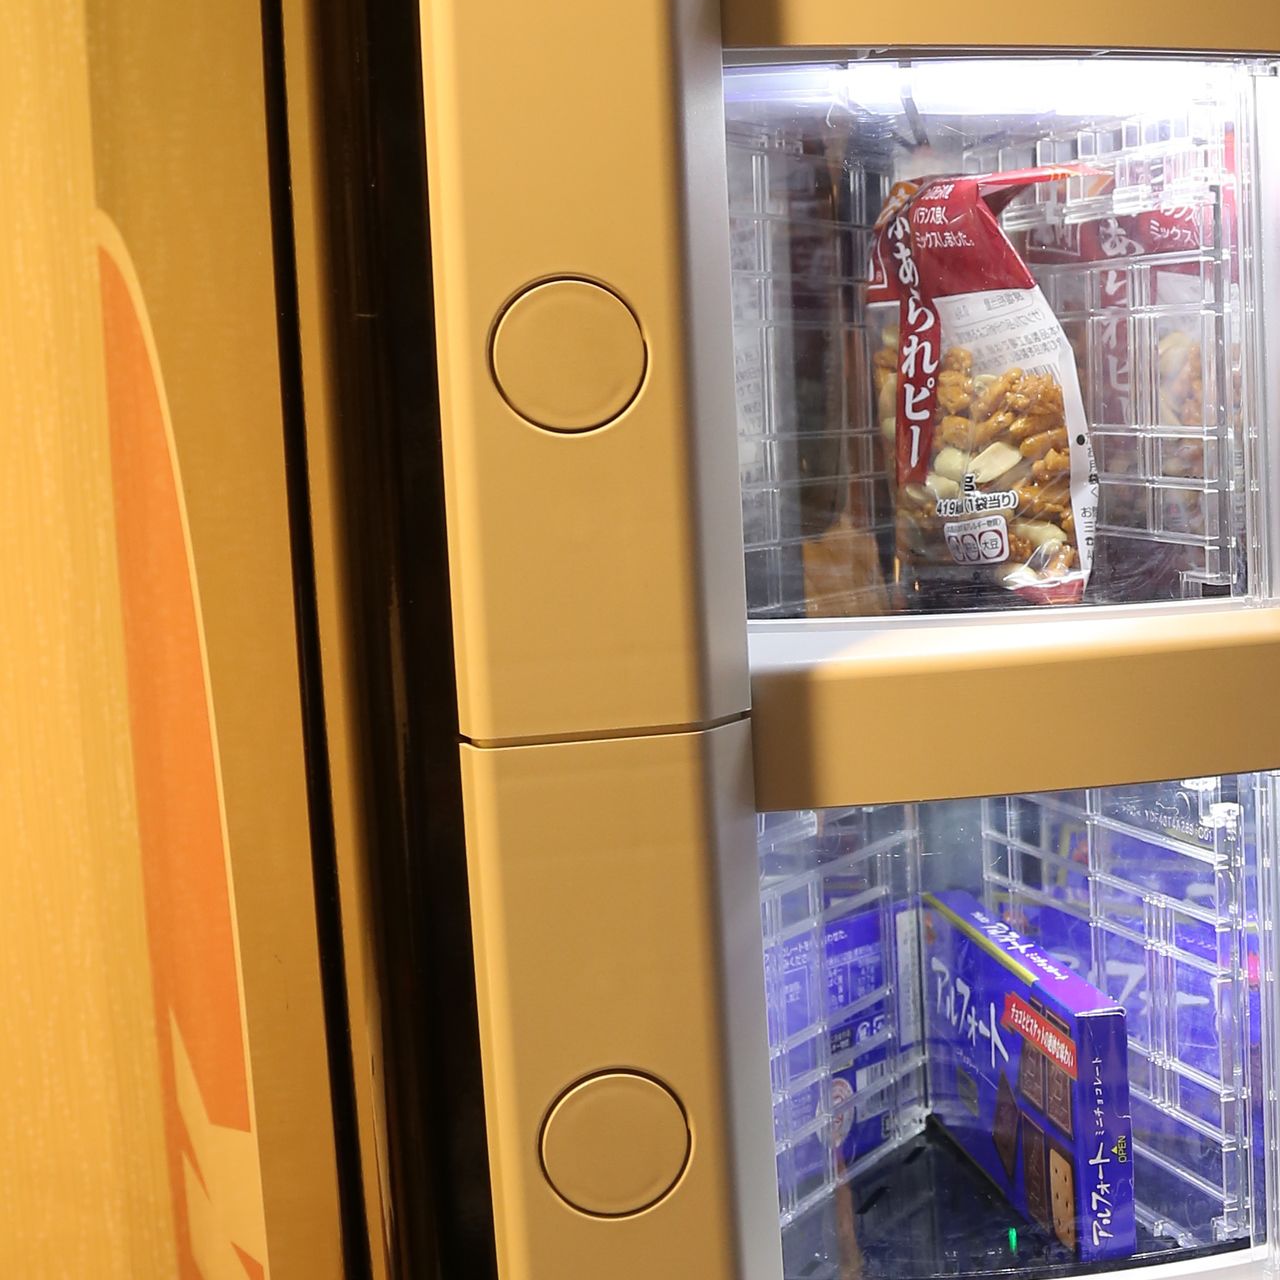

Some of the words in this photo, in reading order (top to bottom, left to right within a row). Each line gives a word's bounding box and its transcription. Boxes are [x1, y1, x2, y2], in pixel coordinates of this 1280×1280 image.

[915, 231, 975, 248] ミックスしました。
[931, 956, 1009, 1069] アルフォート
[1091, 1056, 1105, 1136] ミニチョコレート
[1117, 1135, 1128, 1163] OPEN
[1088, 1141, 1114, 1246] アルフォート
